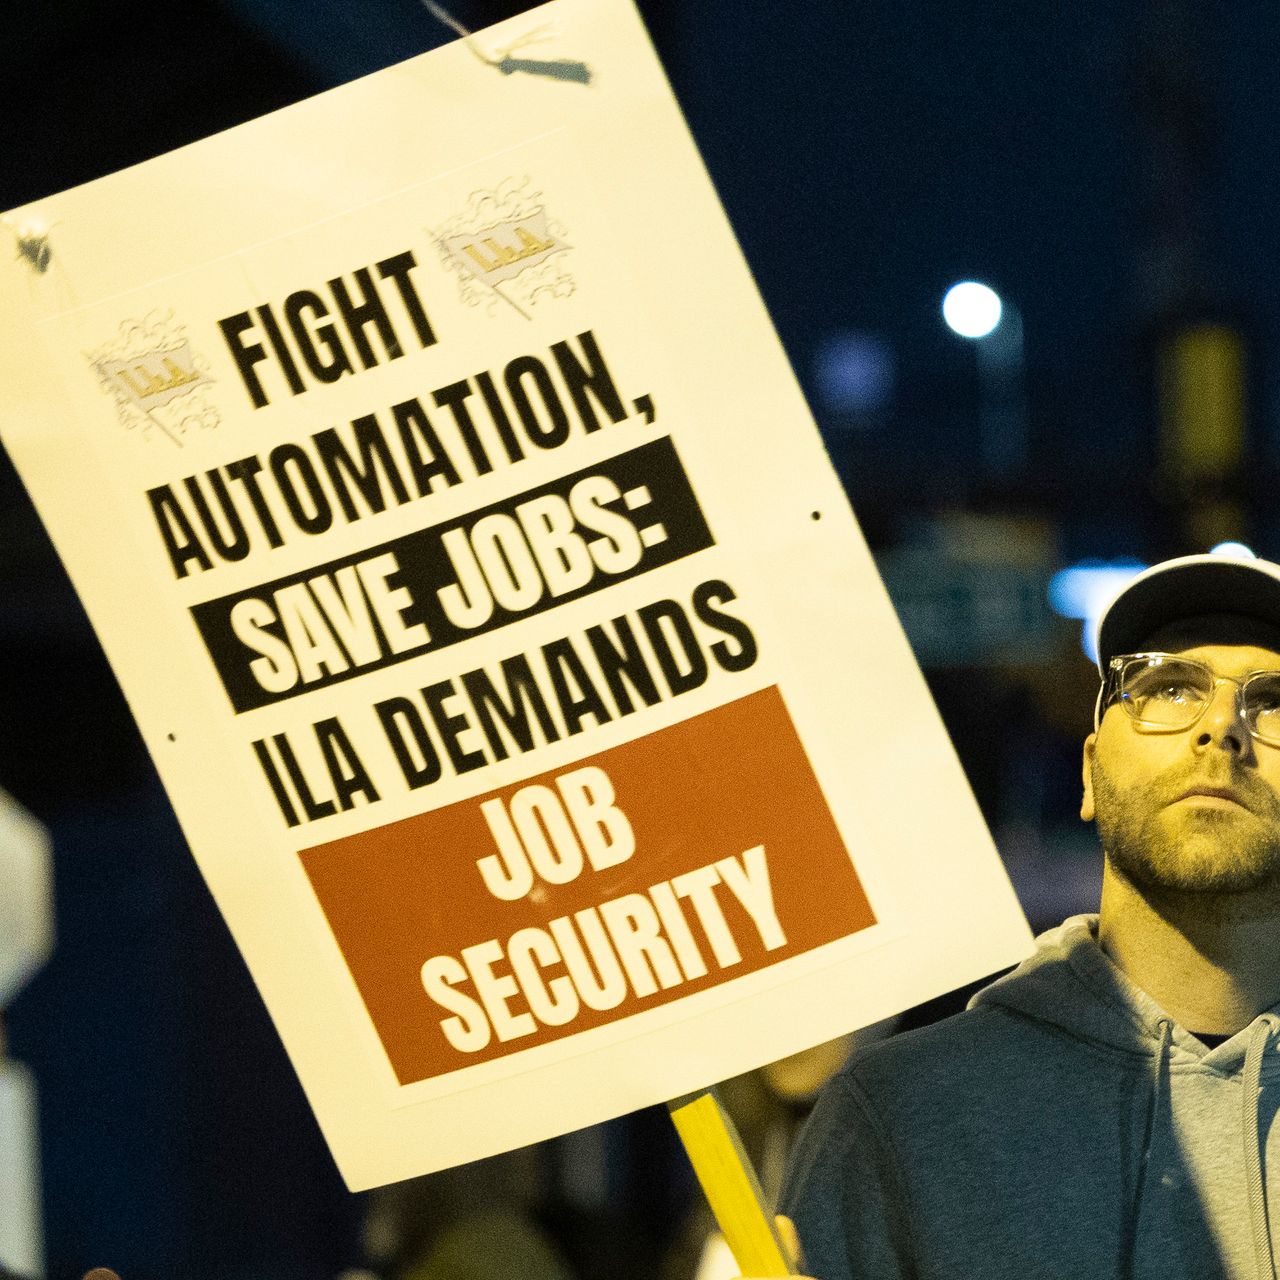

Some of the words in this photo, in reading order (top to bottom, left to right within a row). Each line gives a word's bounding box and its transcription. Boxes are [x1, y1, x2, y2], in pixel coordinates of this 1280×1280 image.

[219, 251, 438, 408] FIGHT
[147, 331, 657, 579] AUTOMATION,
[229, 552, 431, 694] SAVE
[437, 476, 667, 629] JOBS:
[252, 717, 381, 827] ILA
[374, 579, 758, 790] DEMANDS
[476, 765, 637, 902] JOB
[420, 844, 788, 1054] SECURITY
